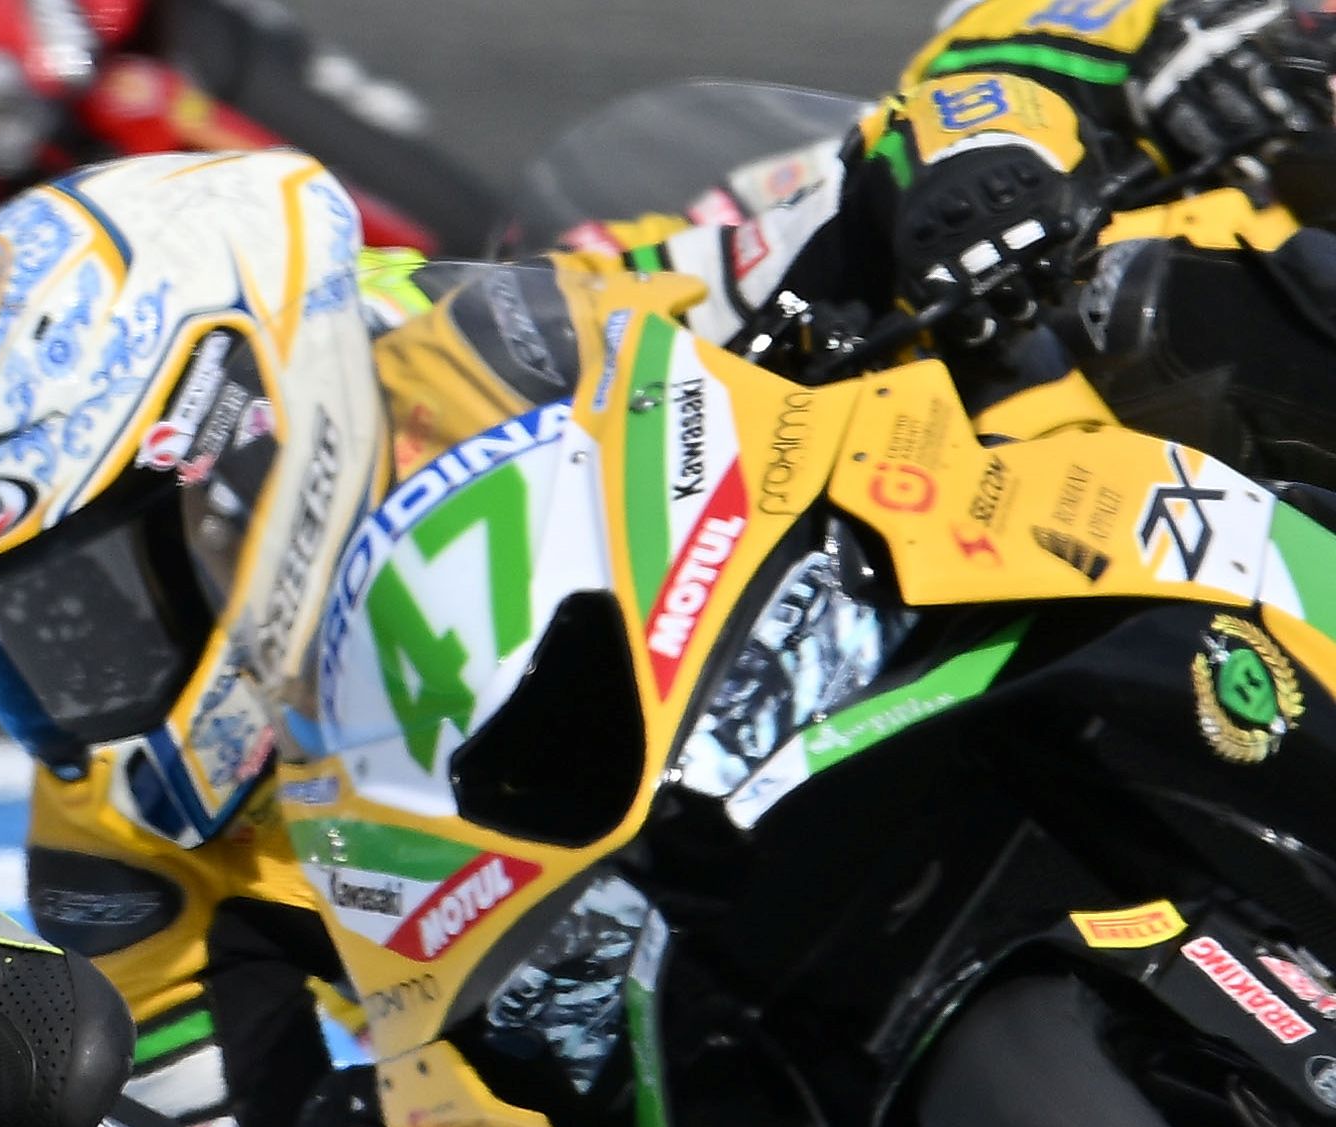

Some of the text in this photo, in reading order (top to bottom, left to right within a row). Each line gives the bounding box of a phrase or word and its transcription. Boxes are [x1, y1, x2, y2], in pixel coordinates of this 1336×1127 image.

[674, 378, 705, 500] Kawasaki
[366, 463, 533, 772] 47
[647, 516, 747, 660] MOTUL
[419, 858, 513, 957] MOTUL
[1191, 943, 1302, 1040] BRAKING
